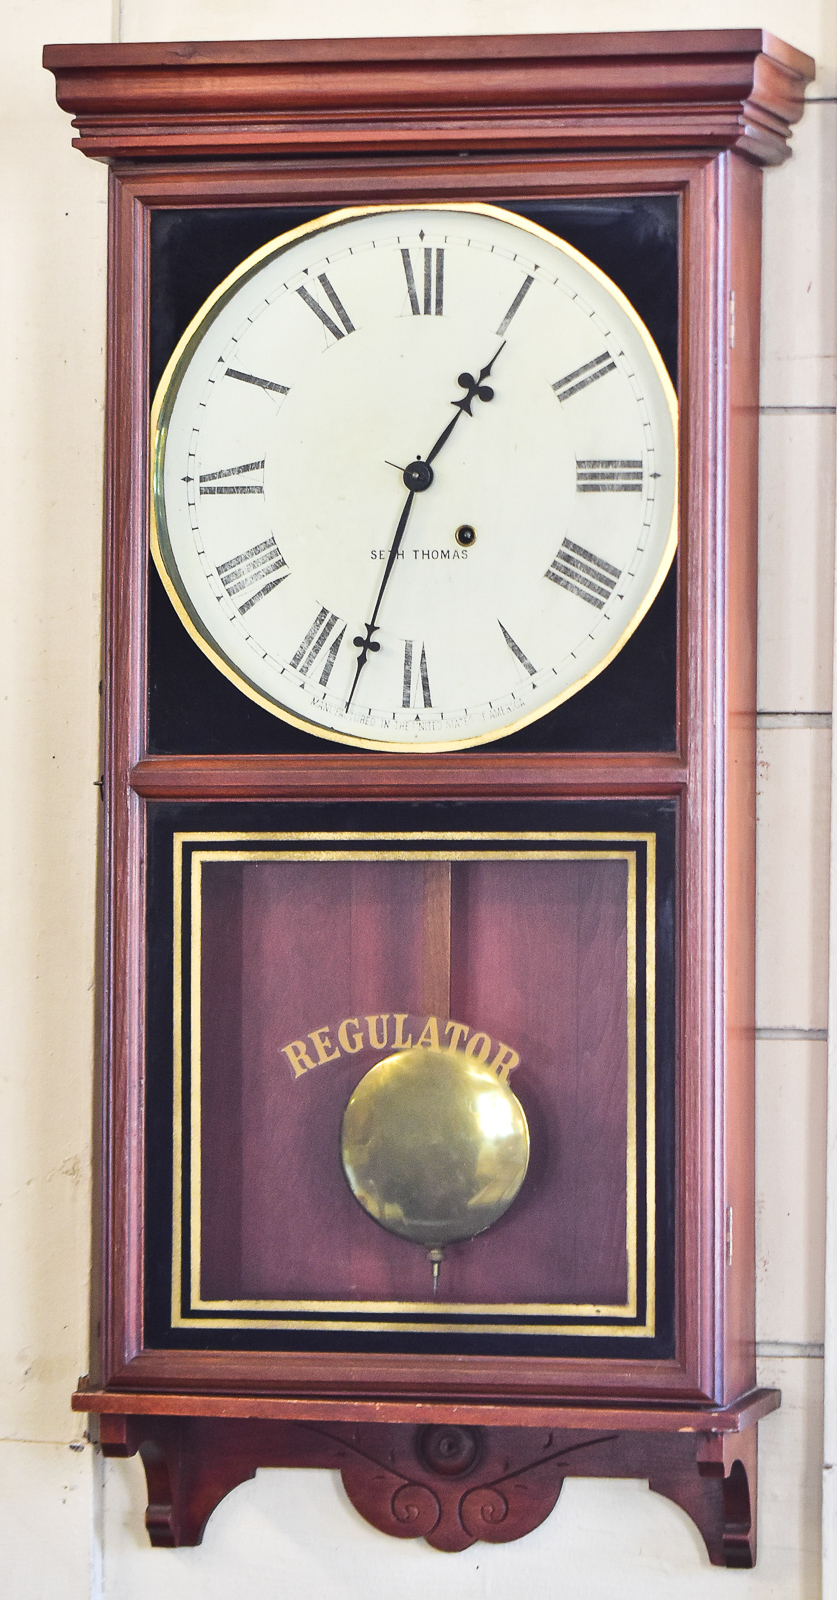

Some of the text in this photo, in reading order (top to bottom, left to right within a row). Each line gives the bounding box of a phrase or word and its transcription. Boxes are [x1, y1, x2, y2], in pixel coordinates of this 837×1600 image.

[296, 272, 361, 353] XI
[400, 247, 449, 317] XII
[494, 274, 536, 336] I
[225, 355, 293, 416] X
[549, 350, 618, 403] II
[198, 454, 266, 500] IX
[575, 454, 645, 494] III
[216, 531, 291, 616] VIII
[413, 549, 469, 561] THOMAS
[544, 533, 623, 610] IIII
[289, 602, 348, 688] VII
[399, 638, 433, 709] VI
[496, 618, 538, 680] V
[381, 716, 391, 728] IN
[281, 1013, 520, 1083] REGULATOR
